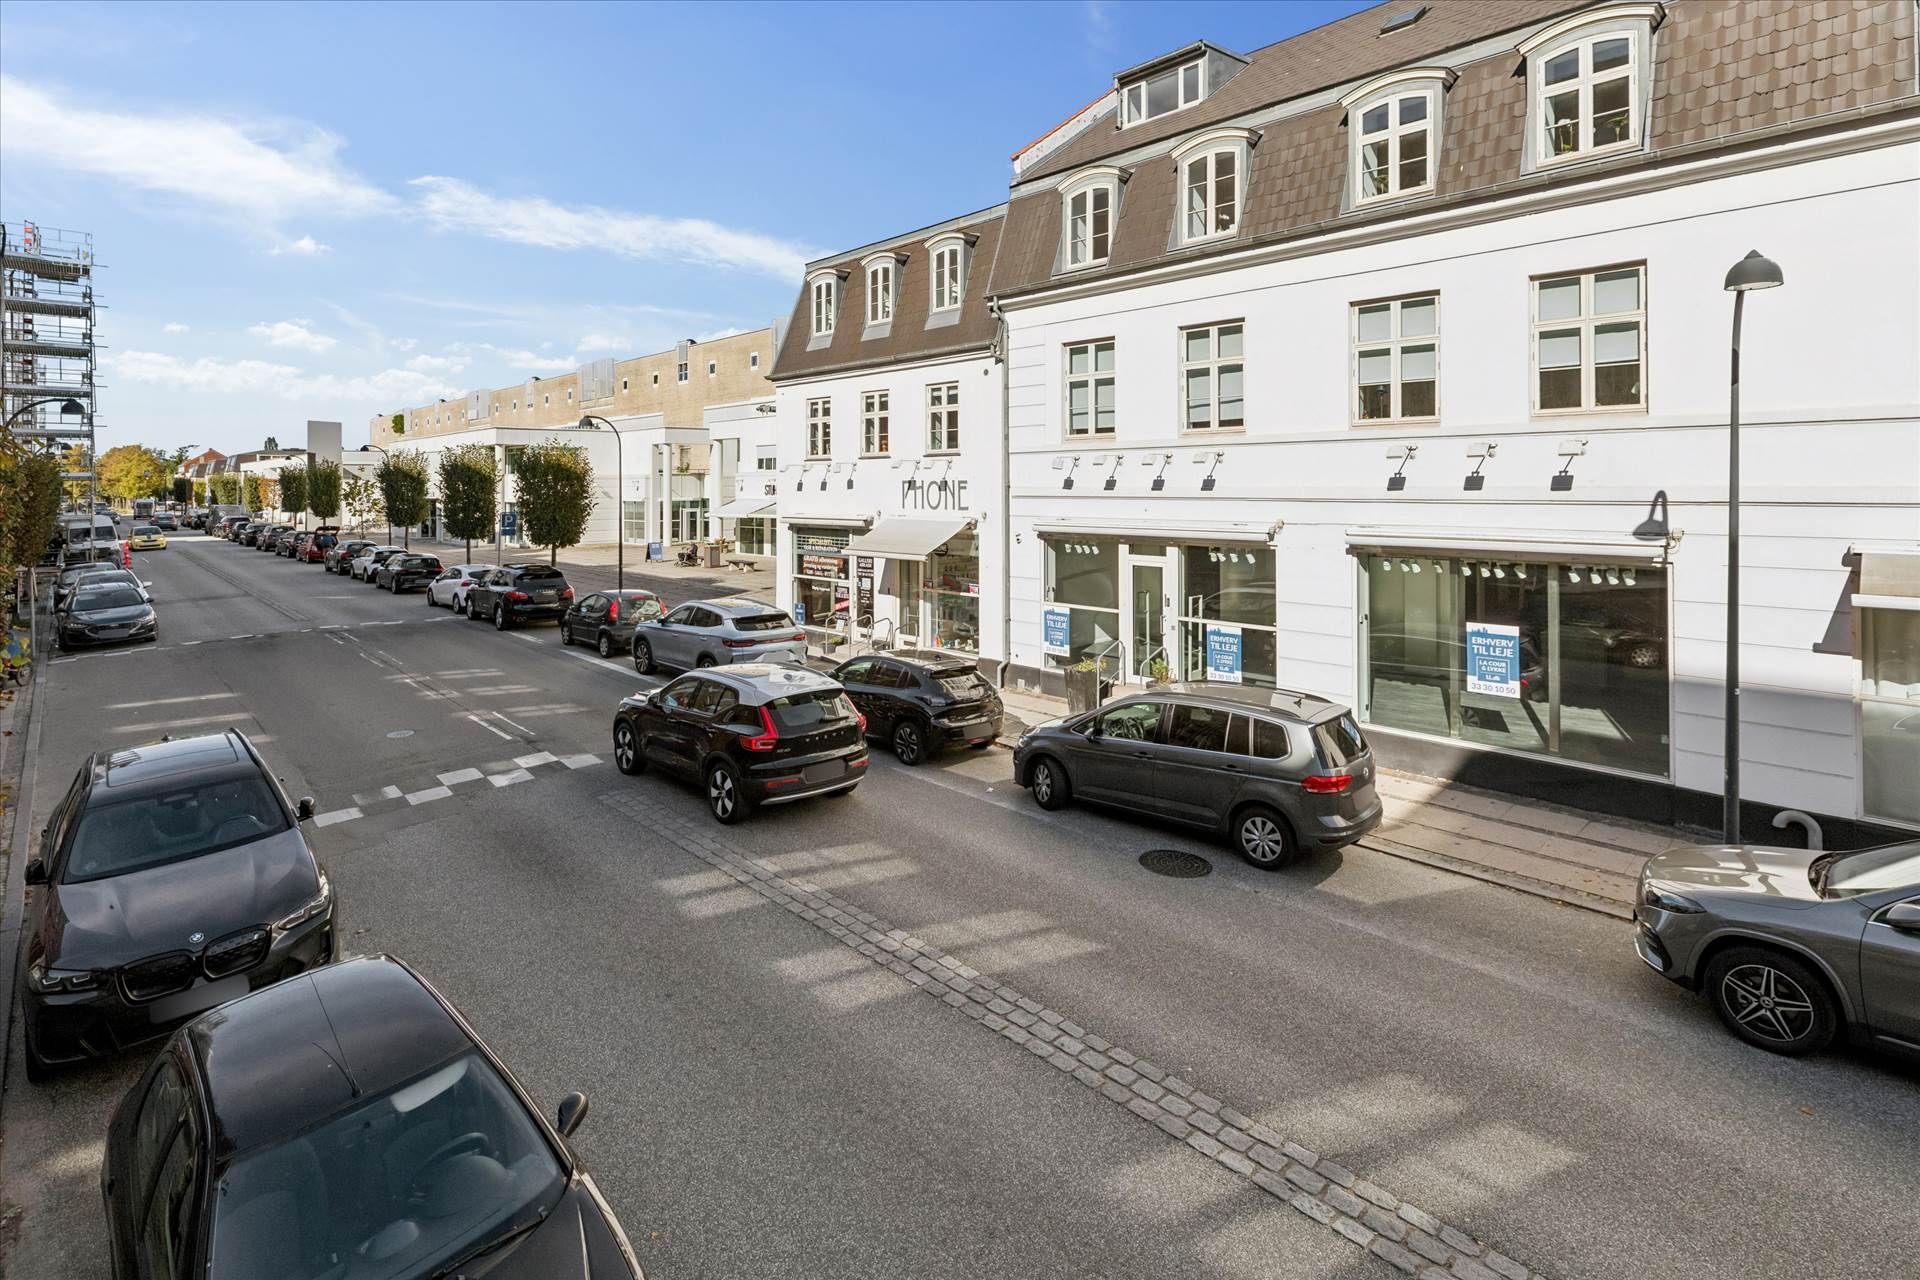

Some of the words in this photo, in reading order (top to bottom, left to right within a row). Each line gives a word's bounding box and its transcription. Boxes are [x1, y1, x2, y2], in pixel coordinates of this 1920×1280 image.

[902, 480, 969, 511] PHONE
[504, 516, 512, 527] P
[1210, 635, 1238, 644] ERHVERV
[1471, 636, 1514, 648] ERHVERV
[1210, 641, 1221, 650] TIL
[1222, 643, 1238, 652] LEJE
[1471, 645, 1489, 655] TIL
[1489, 648, 1514, 658] LEJE
[1471, 682, 1481, 690] 33
[1495, 685, 1505, 693] 10
[1505, 687, 1516, 695] 50
